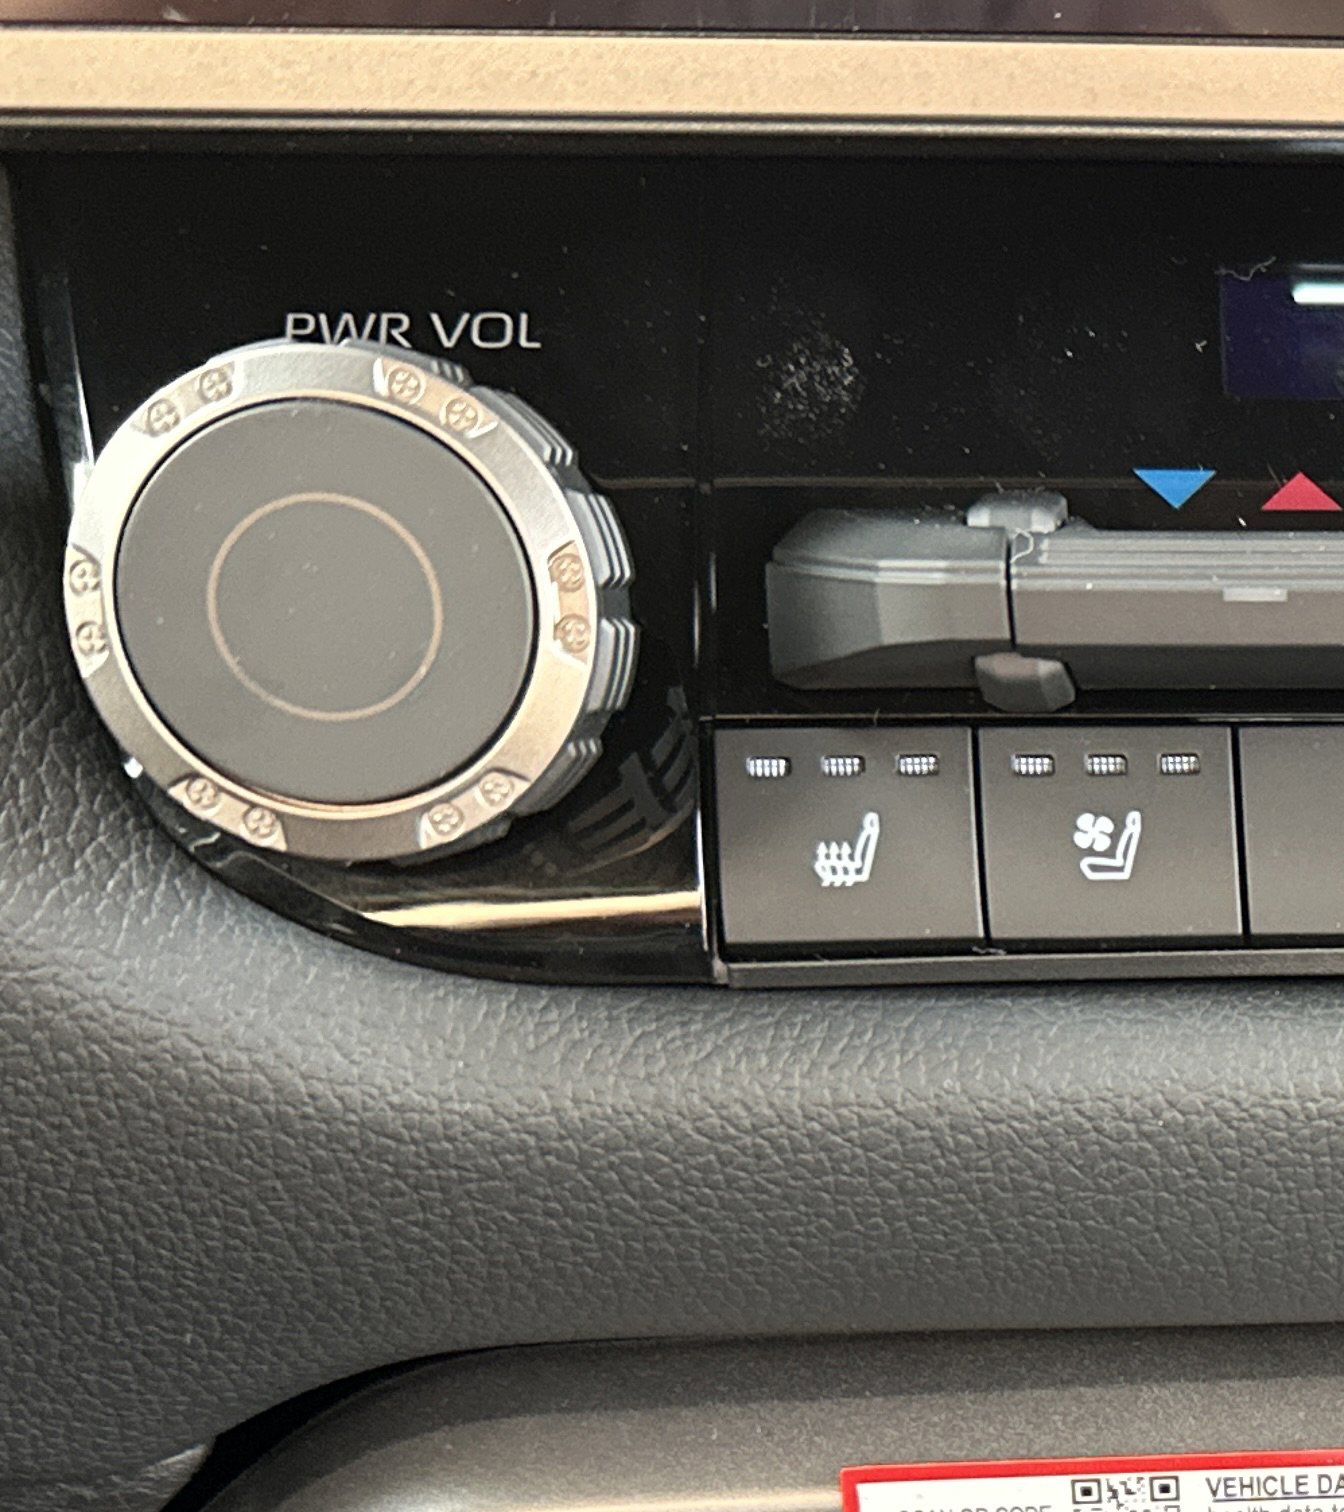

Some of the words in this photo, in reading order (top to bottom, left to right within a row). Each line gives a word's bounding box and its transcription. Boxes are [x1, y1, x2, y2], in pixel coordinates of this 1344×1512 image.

[285, 312, 412, 348] PWR
[429, 312, 542, 349] VOL
[1205, 1473, 1310, 1499] VEHICLE
